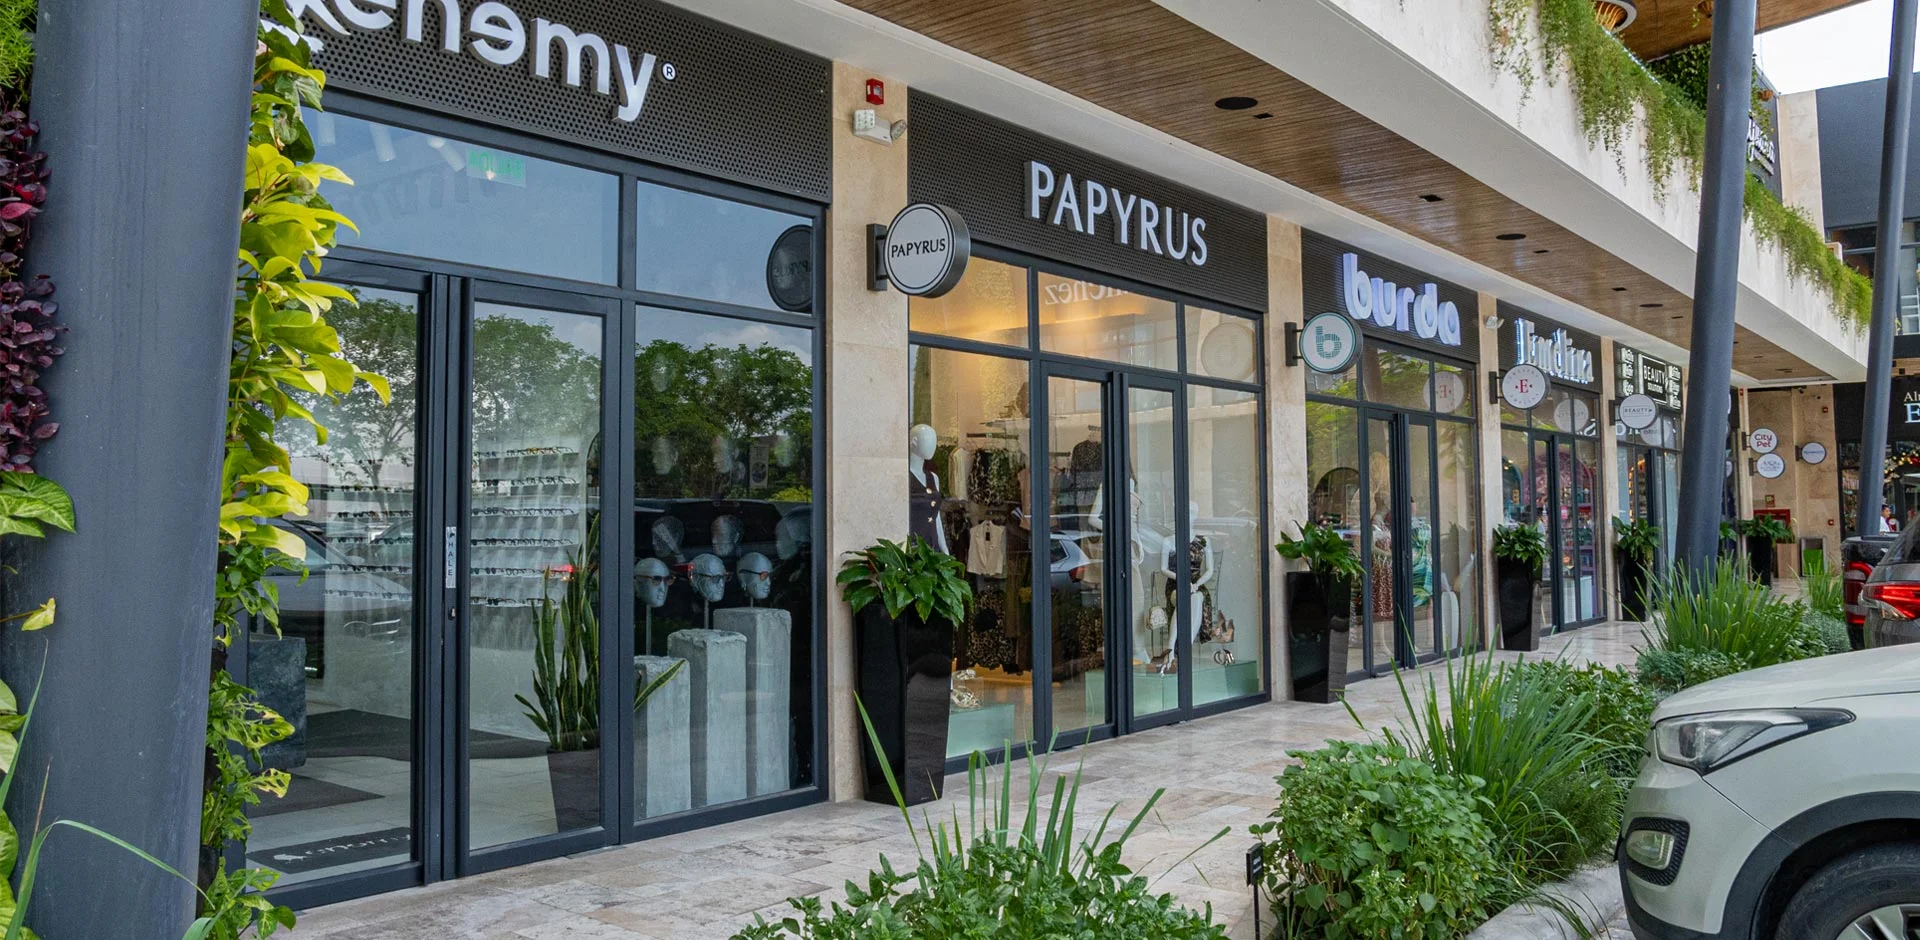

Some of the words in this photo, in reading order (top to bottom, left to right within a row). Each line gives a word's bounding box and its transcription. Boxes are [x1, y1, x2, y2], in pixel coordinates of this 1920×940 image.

[1028, 160, 1208, 266] PAPYRUS
[891, 238, 946, 258] PAPYRUS
[1342, 252, 1461, 346] burda
[1315, 325, 1343, 359] b
[1643, 364, 1665, 385] BEAUTY
[1754, 433, 1773, 441] City
[1756, 440, 1771, 448] Pet
